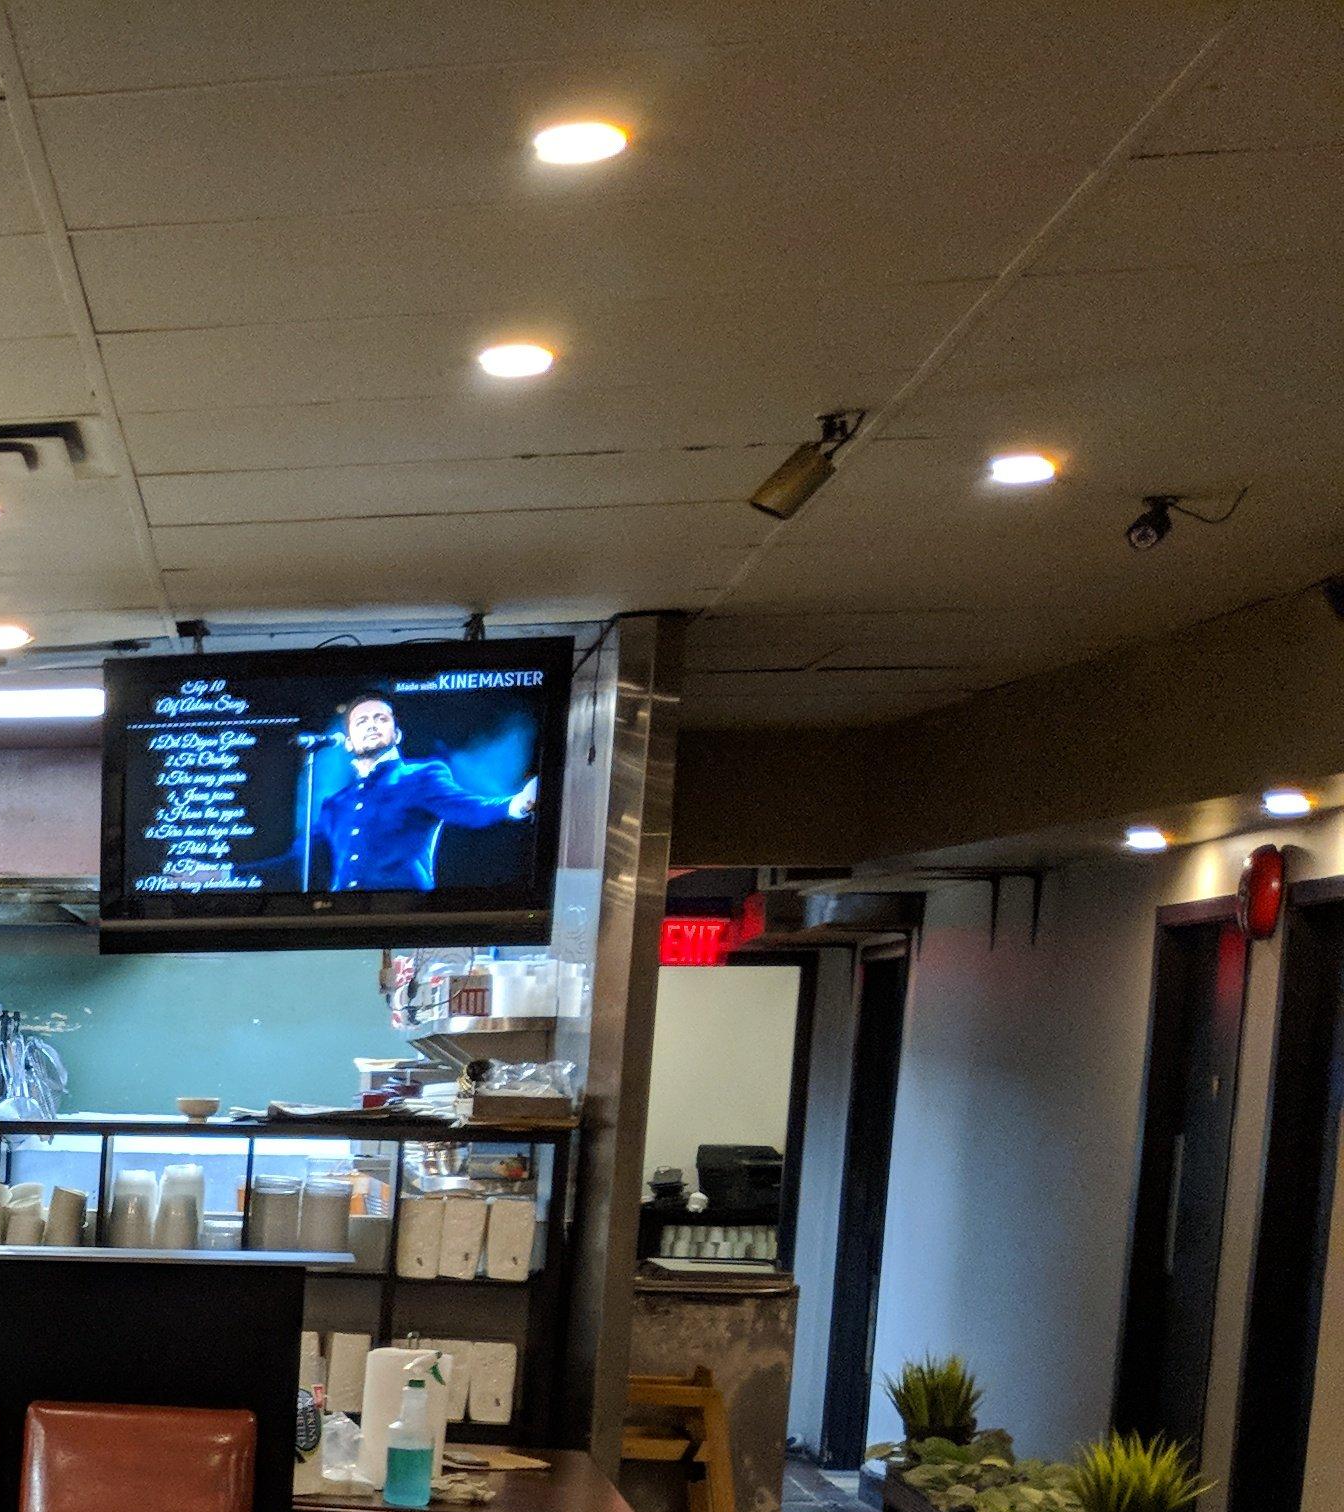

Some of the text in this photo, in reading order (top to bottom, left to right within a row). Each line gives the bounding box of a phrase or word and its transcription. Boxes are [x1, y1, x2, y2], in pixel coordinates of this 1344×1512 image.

[210, 679, 227, 692] 10
[439, 670, 544, 690] KINEMASTER
[666, 924, 721, 962] EXIT
